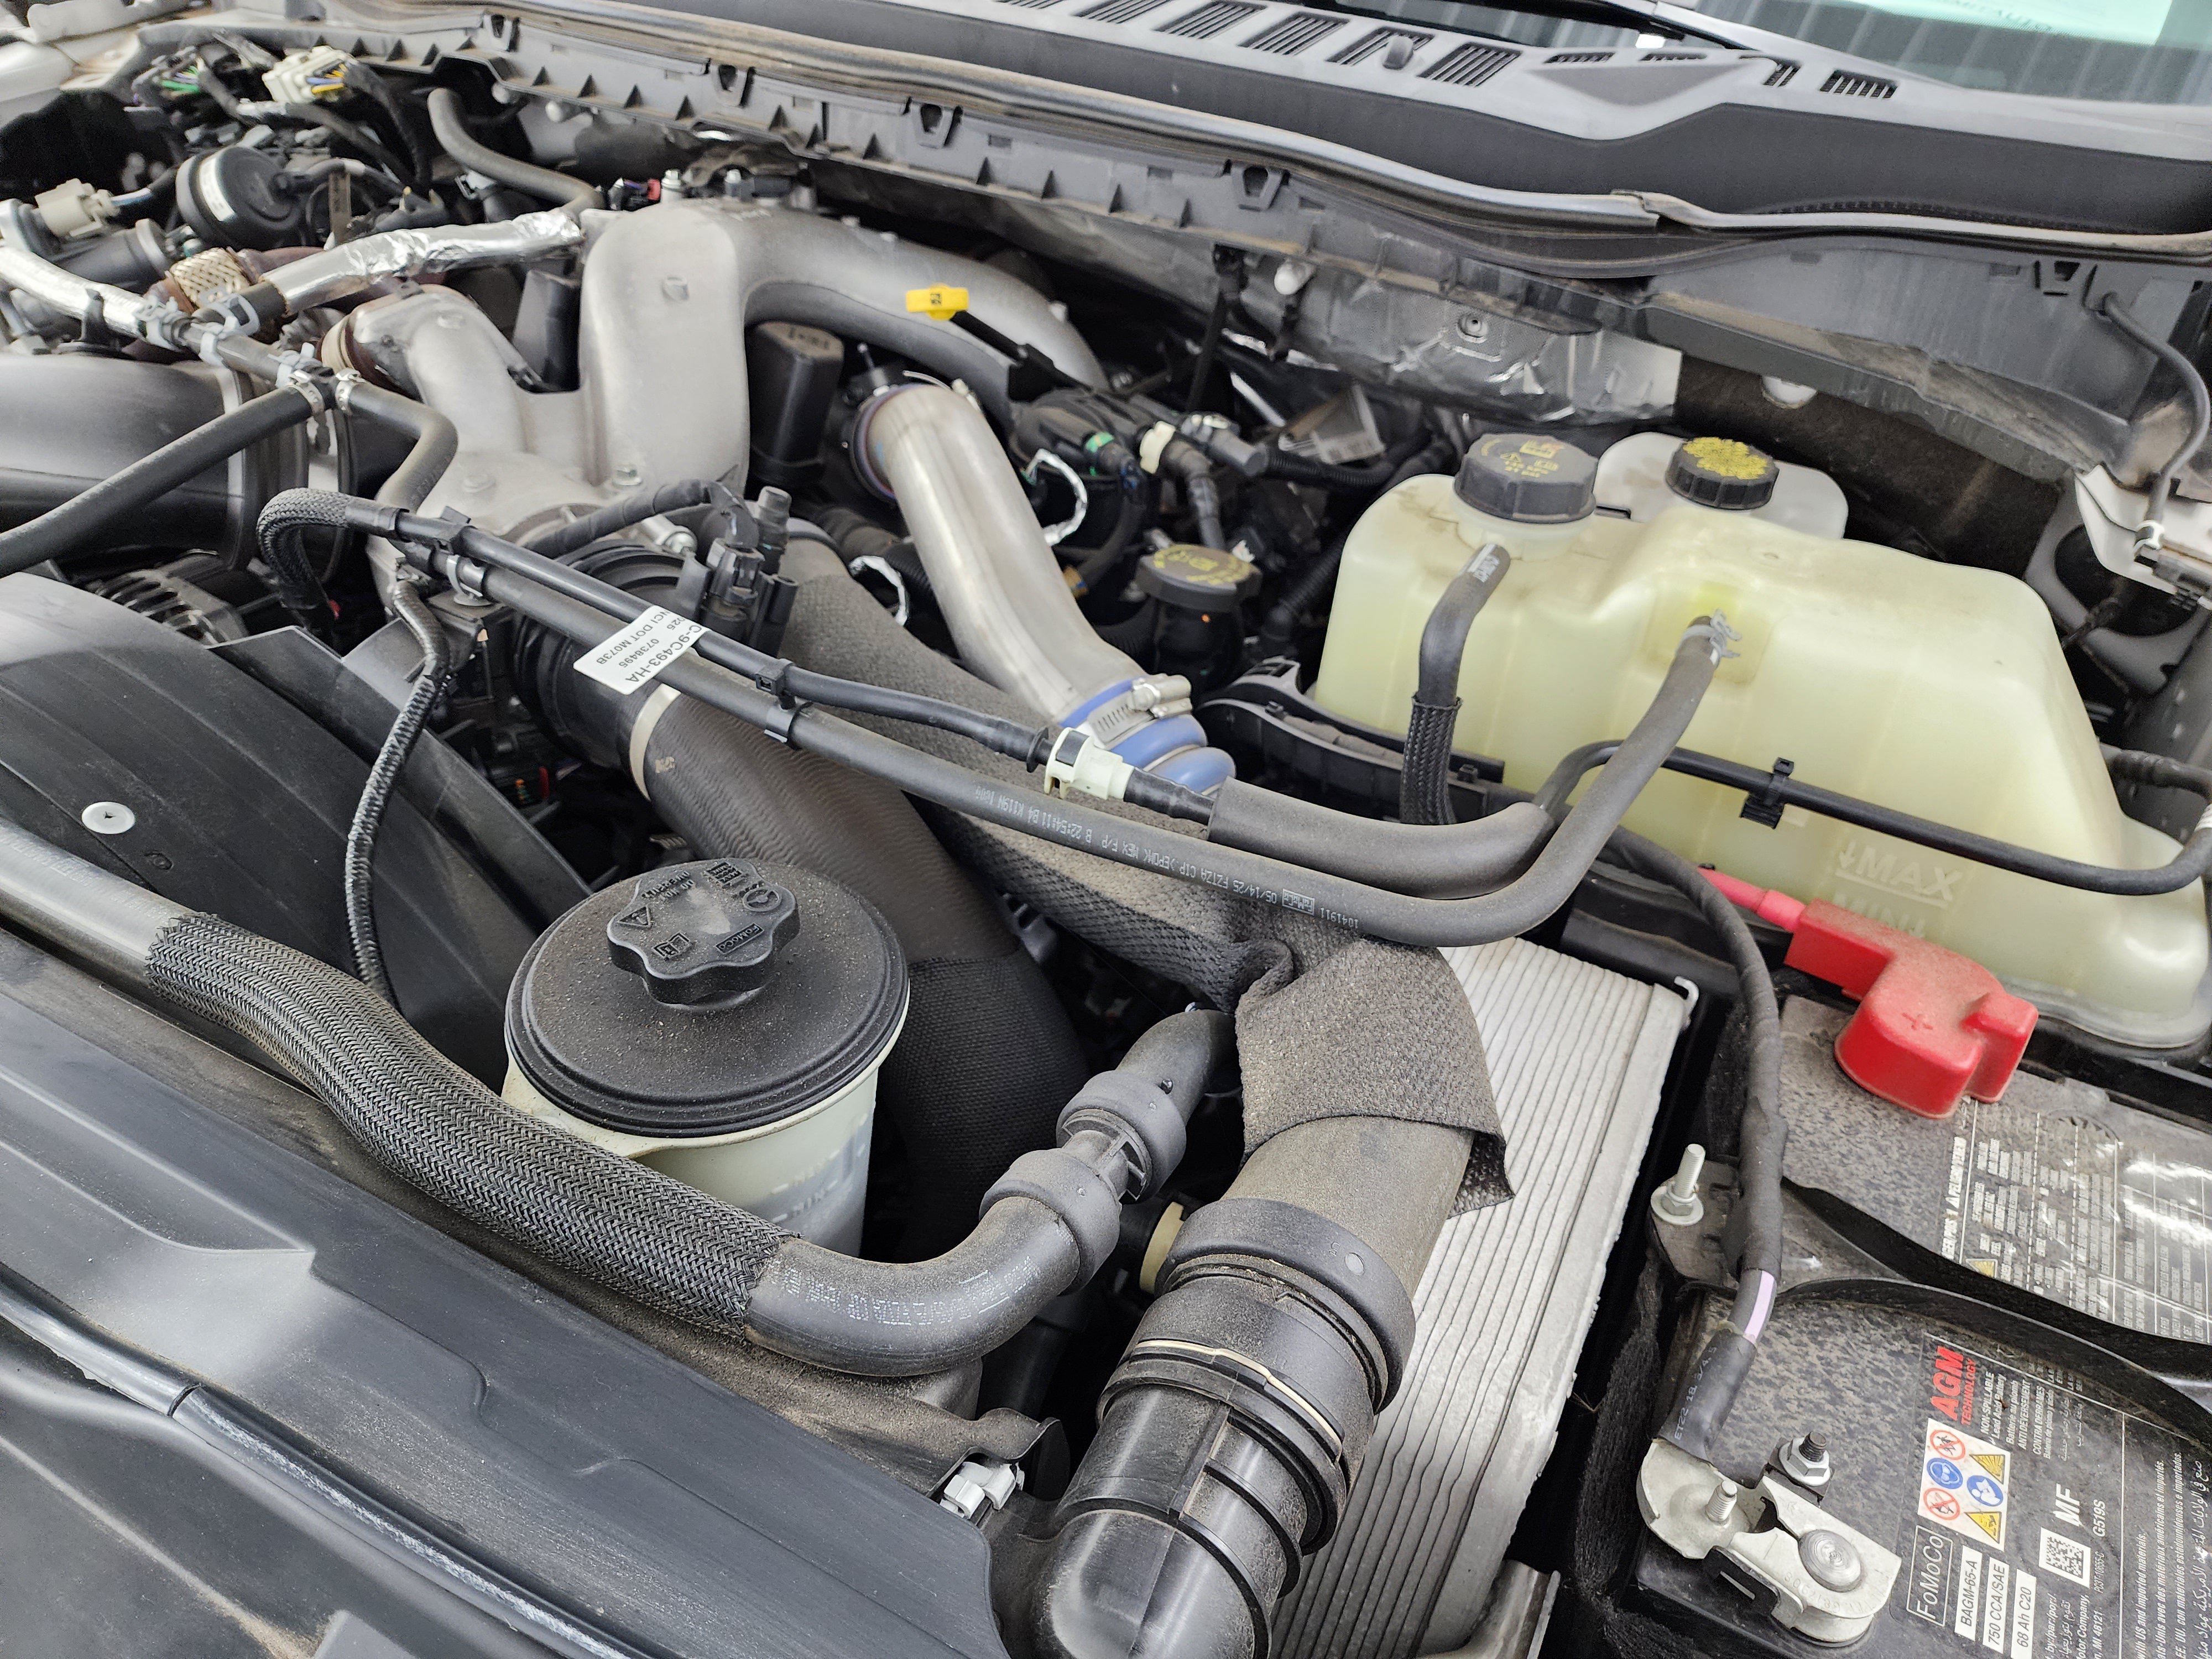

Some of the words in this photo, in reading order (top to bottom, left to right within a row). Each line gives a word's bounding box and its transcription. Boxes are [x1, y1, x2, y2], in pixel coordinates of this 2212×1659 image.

[629, 624, 653, 641] DOT
[596, 639, 631, 665] M073B
[619, 638, 659, 668] 0738495
[1855, 846, 1963, 901] MAX
[1931, 1345, 1965, 1421] AGM
[1961, 1358, 1976, 1426] TECHNOLOGY
[1980, 1370, 1994, 1435] NON-SPILLABLE
[1991, 1416, 2001, 1439] Lead
[2033, 1423, 2043, 1456] CONTRA
[2053, 1483, 2081, 1527] MF
[2155, 1493, 2164, 1503] et
[2093, 1499, 2106, 1538] G519S
[1916, 1535, 1944, 1620] FoMoCo
[1960, 1559, 1977, 1627] BAGM-65-A
[1989, 1564, 2005, 1621] CCA/SAE
[2019, 1585, 2032, 1612] C20
[2156, 1584, 2166, 1603] des
[2018, 1613, 2030, 1631] Ah
[2077, 1592, 2090, 1640] Company,
[2093, 1609, 2103, 1638] 48121
[2136, 1608, 2146, 1627] and
[2177, 1608, 2185, 1626] con
[1987, 1622, 2001, 1646] 750
[2017, 1631, 2028, 1648] 68
[2135, 1625, 2146, 1641] US
